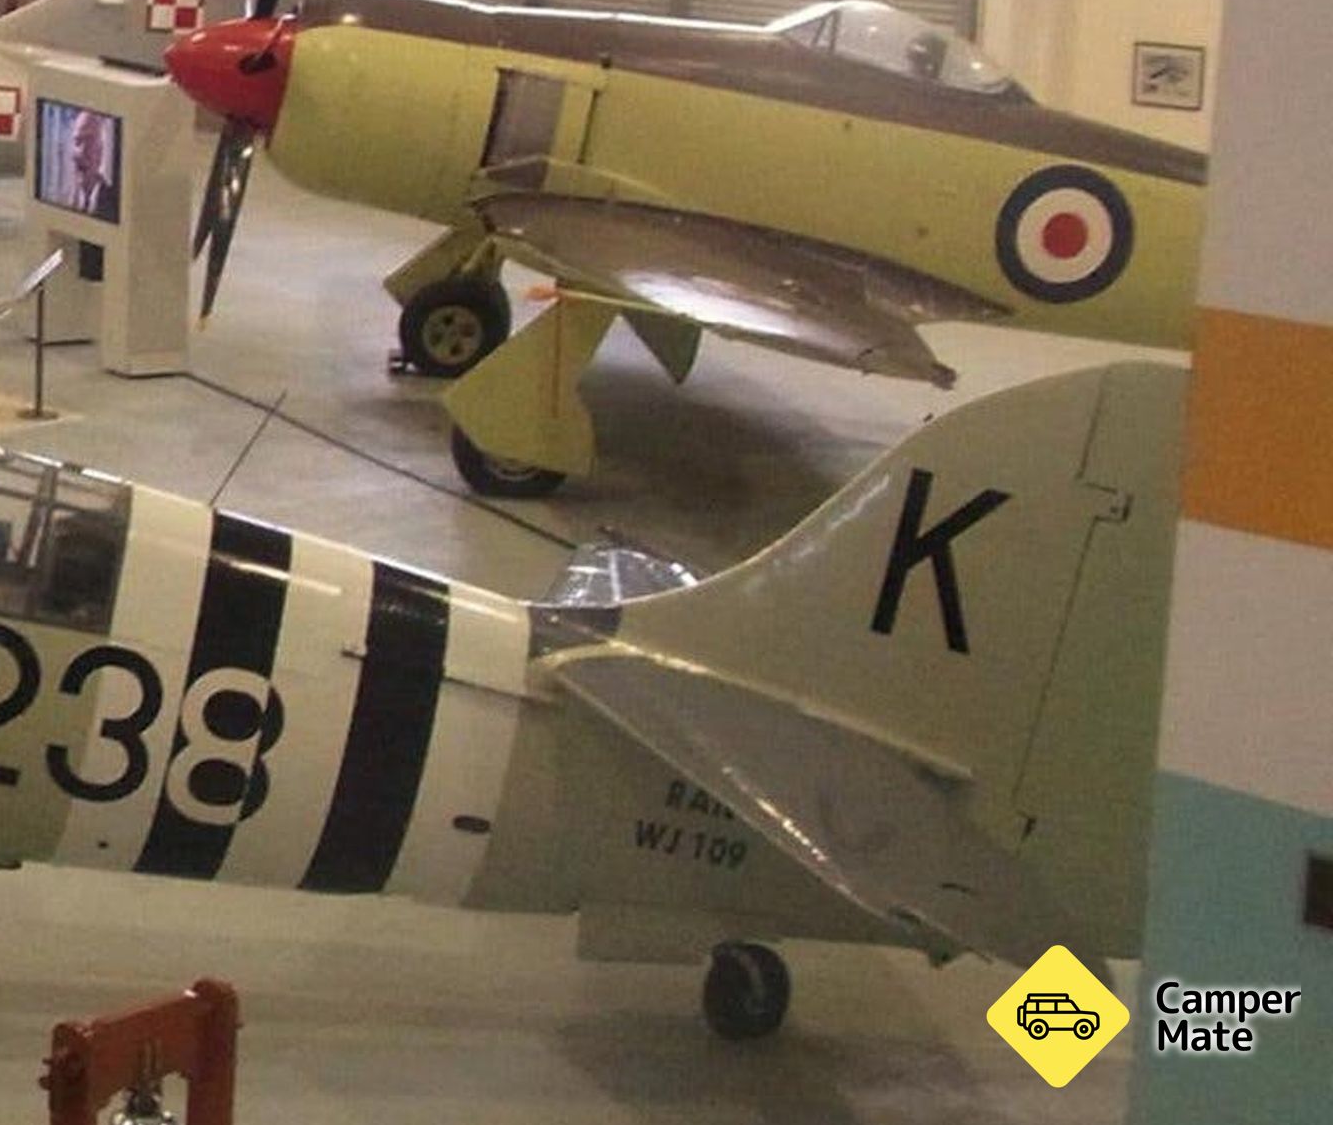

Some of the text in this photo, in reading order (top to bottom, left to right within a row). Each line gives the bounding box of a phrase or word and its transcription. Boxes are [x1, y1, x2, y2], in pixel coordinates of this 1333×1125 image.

[870, 466, 1012, 655] K
[635, 819, 749, 869] WJ 109
